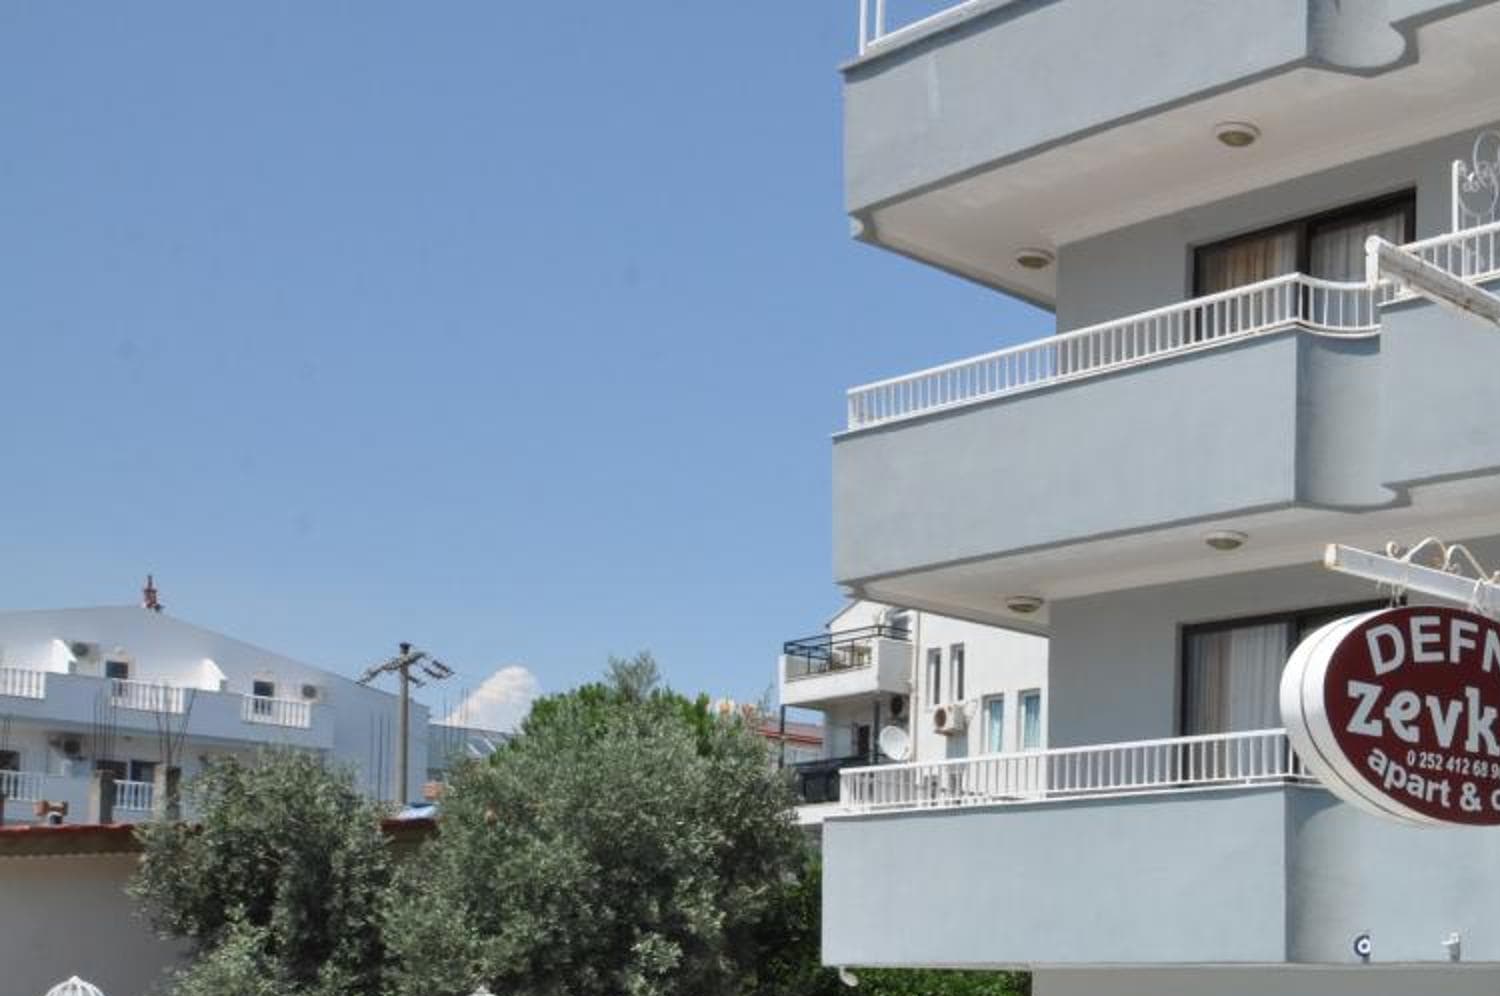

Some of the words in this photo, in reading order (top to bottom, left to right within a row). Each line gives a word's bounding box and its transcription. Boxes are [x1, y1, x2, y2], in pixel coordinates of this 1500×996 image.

[1368, 748, 1451, 808] apart
[1460, 782, 1482, 811] &
[1407, 750, 1416, 766] 0
[1419, 752, 1443, 771] 252
[1446, 755, 1470, 775] 412
